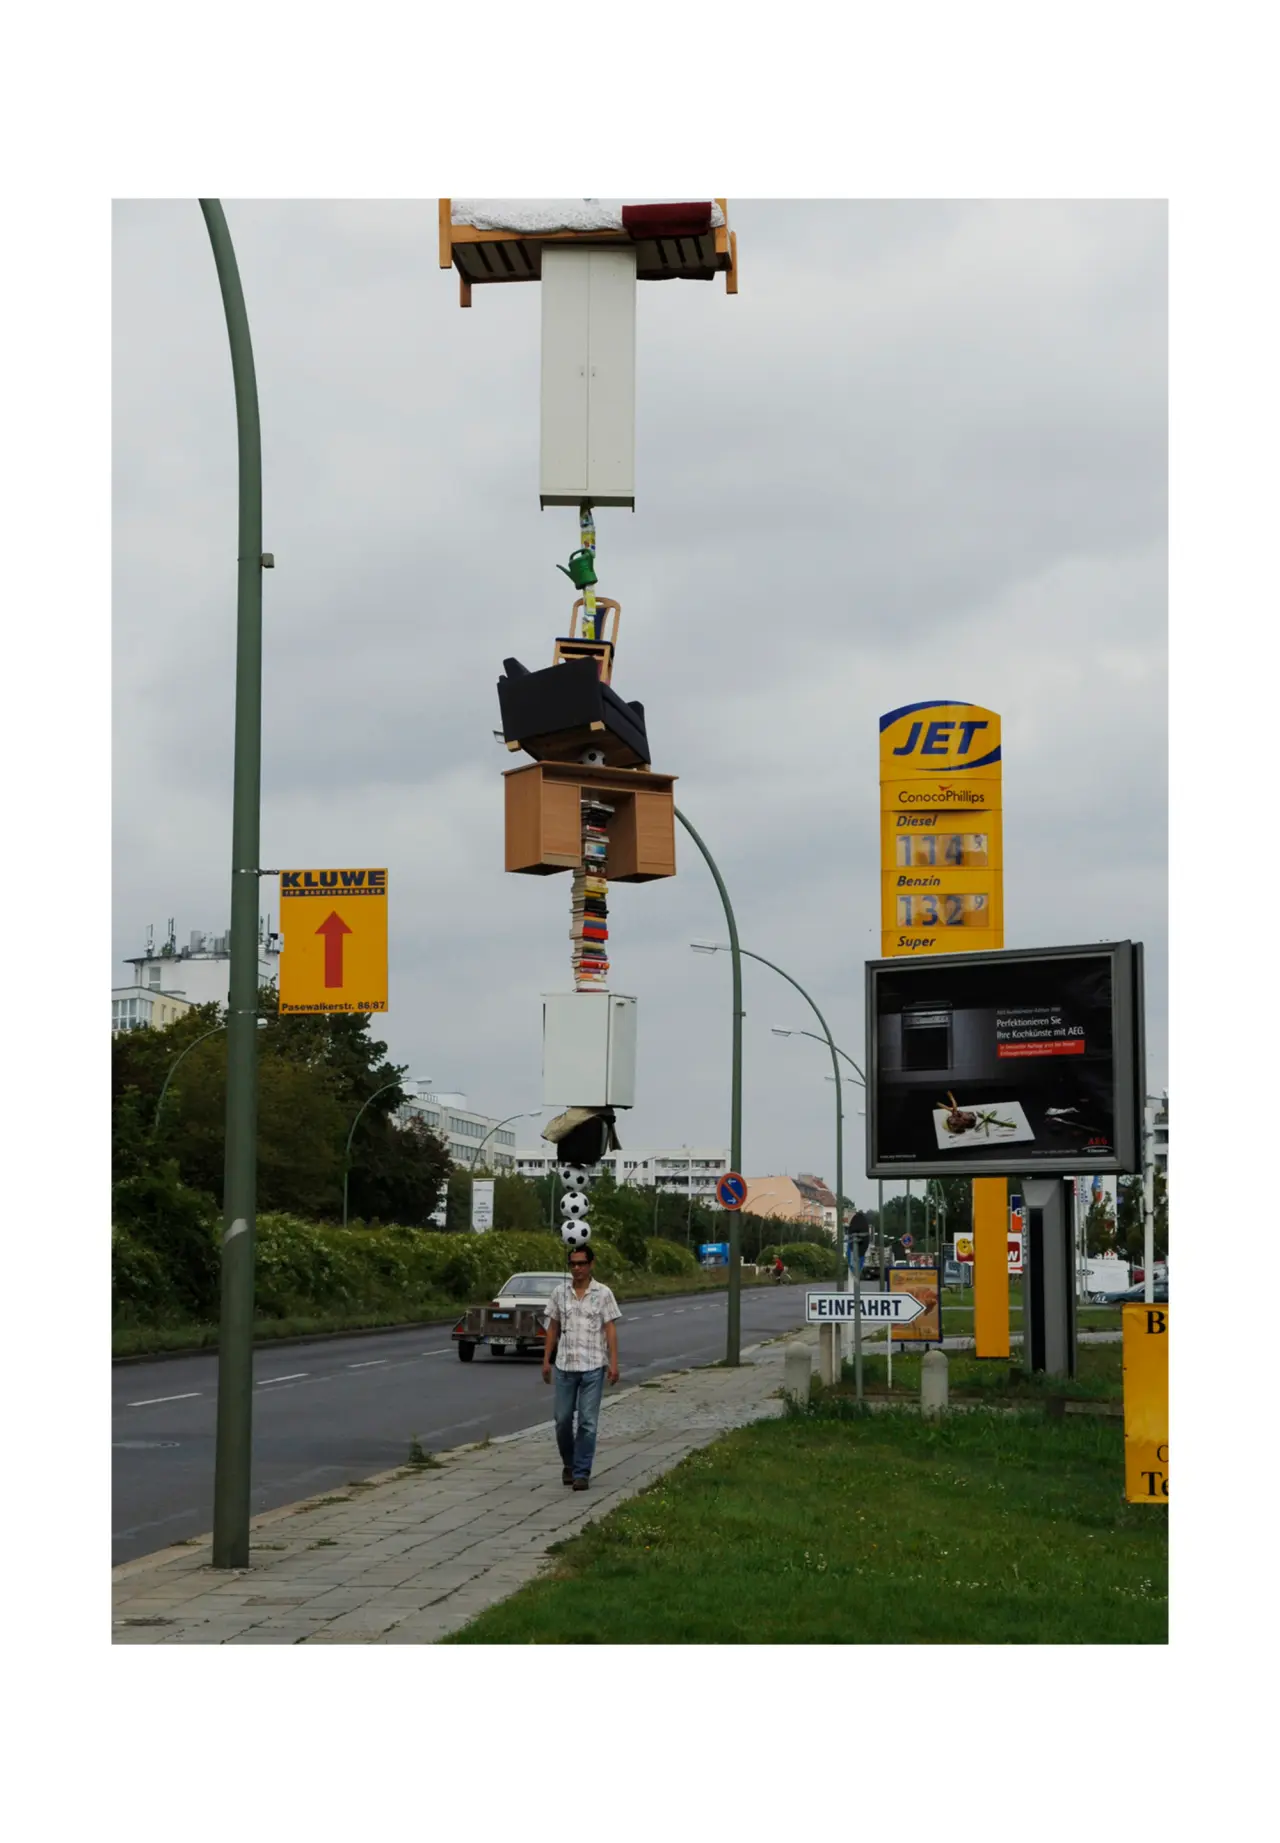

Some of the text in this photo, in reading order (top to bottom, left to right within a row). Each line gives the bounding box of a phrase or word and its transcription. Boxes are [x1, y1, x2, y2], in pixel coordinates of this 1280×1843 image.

[893, 721, 989, 755] JET
[898, 790, 985, 804] ConocoPhillips
[896, 815, 938, 828] Diesel
[282, 871, 385, 887] KLUWE
[896, 875, 940, 887] Benzin
[897, 936, 936, 950] Super
[282, 1001, 385, 1012] Pasewalkerstr. 86/87
[996, 1015, 1062, 1028] Perfektionieren Sie
[996, 1030, 1010, 1040] Ihre
[1012, 1028, 1052, 1039] Kochkünste
[1053, 1027, 1066, 1036] mit
[817, 1298, 902, 1317] EINFAHRT
